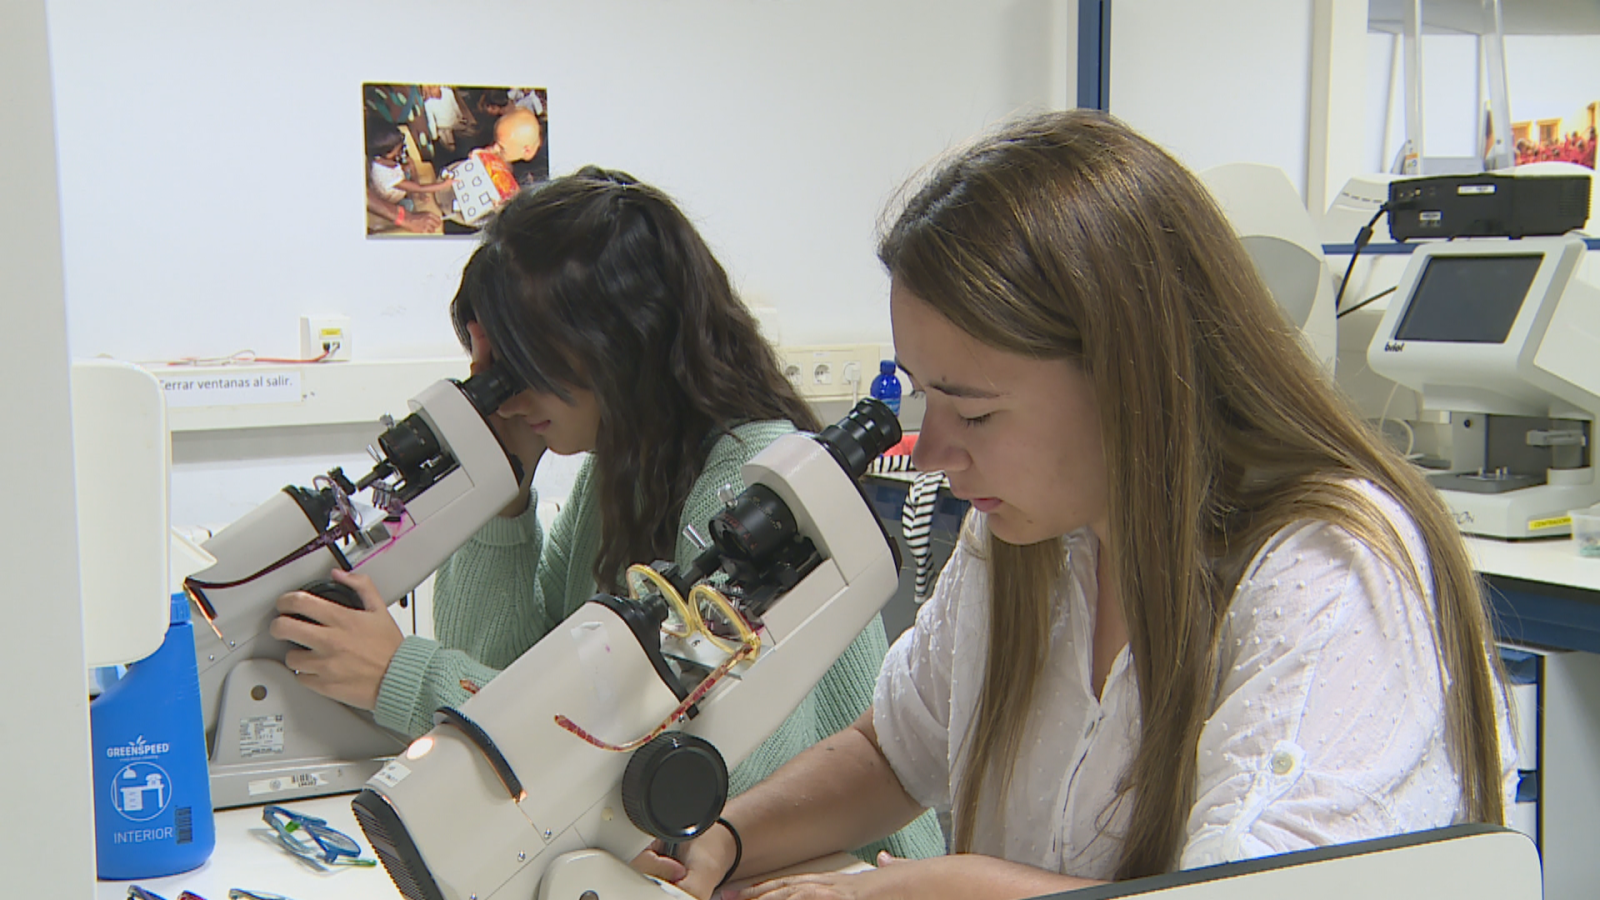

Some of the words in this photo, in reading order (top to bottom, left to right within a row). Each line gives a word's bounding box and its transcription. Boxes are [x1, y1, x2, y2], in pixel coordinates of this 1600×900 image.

[198, 378, 250, 389] ventanas
[253, 376, 263, 386] al
[266, 375, 292, 386] salir.
[106, 743, 169, 758] GREENSPEED
[114, 826, 173, 844] INTERIOR
